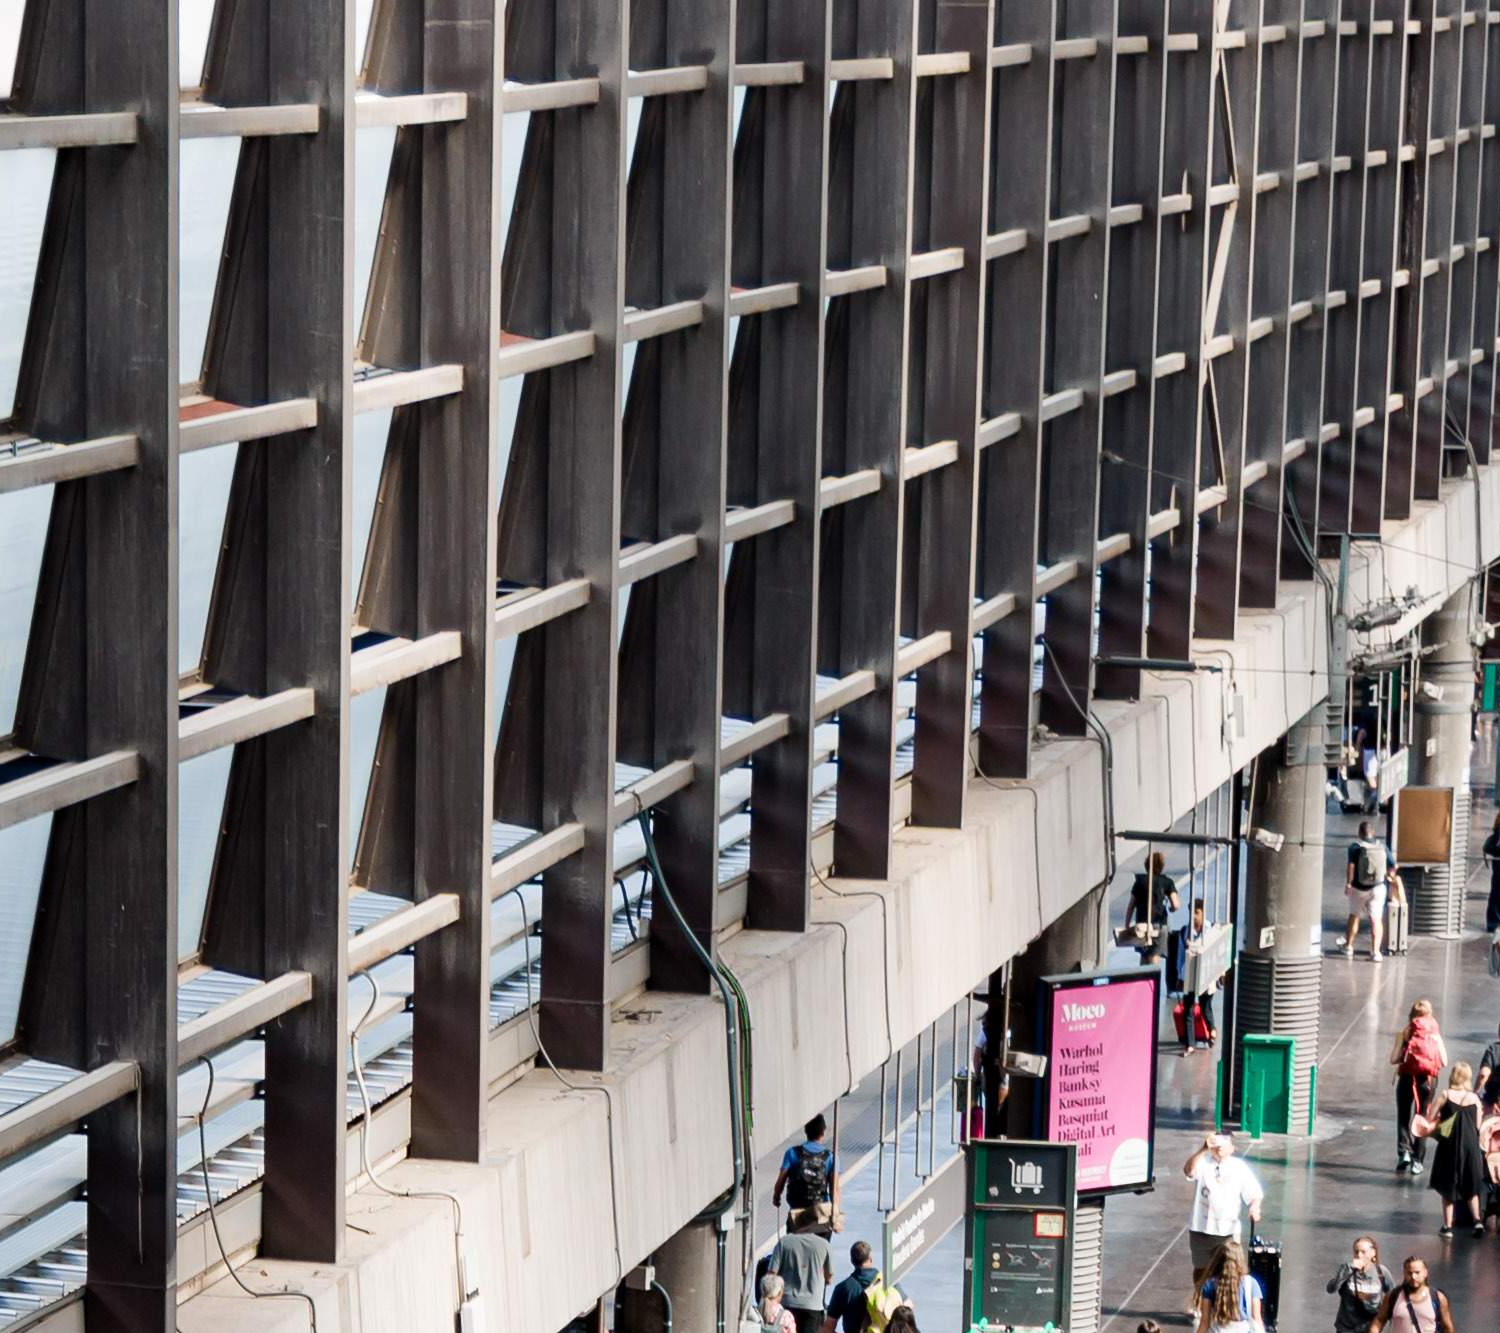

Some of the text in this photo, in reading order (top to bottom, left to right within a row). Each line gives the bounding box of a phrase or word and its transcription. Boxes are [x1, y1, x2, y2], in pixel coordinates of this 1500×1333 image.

[1368, 683, 1379, 707] 1
[1061, 1003, 1106, 1023] Moco
[1060, 1042, 1103, 1059] Warhol
[1059, 1060, 1100, 1077] Haring
[1059, 1078, 1101, 1094] Banksy
[1059, 1095, 1106, 1110] Kusama
[1058, 1109, 1109, 1127] Basquiat
[1057, 1124, 1116, 1143] Digital Art
[1078, 1142, 1093, 1157] alí
